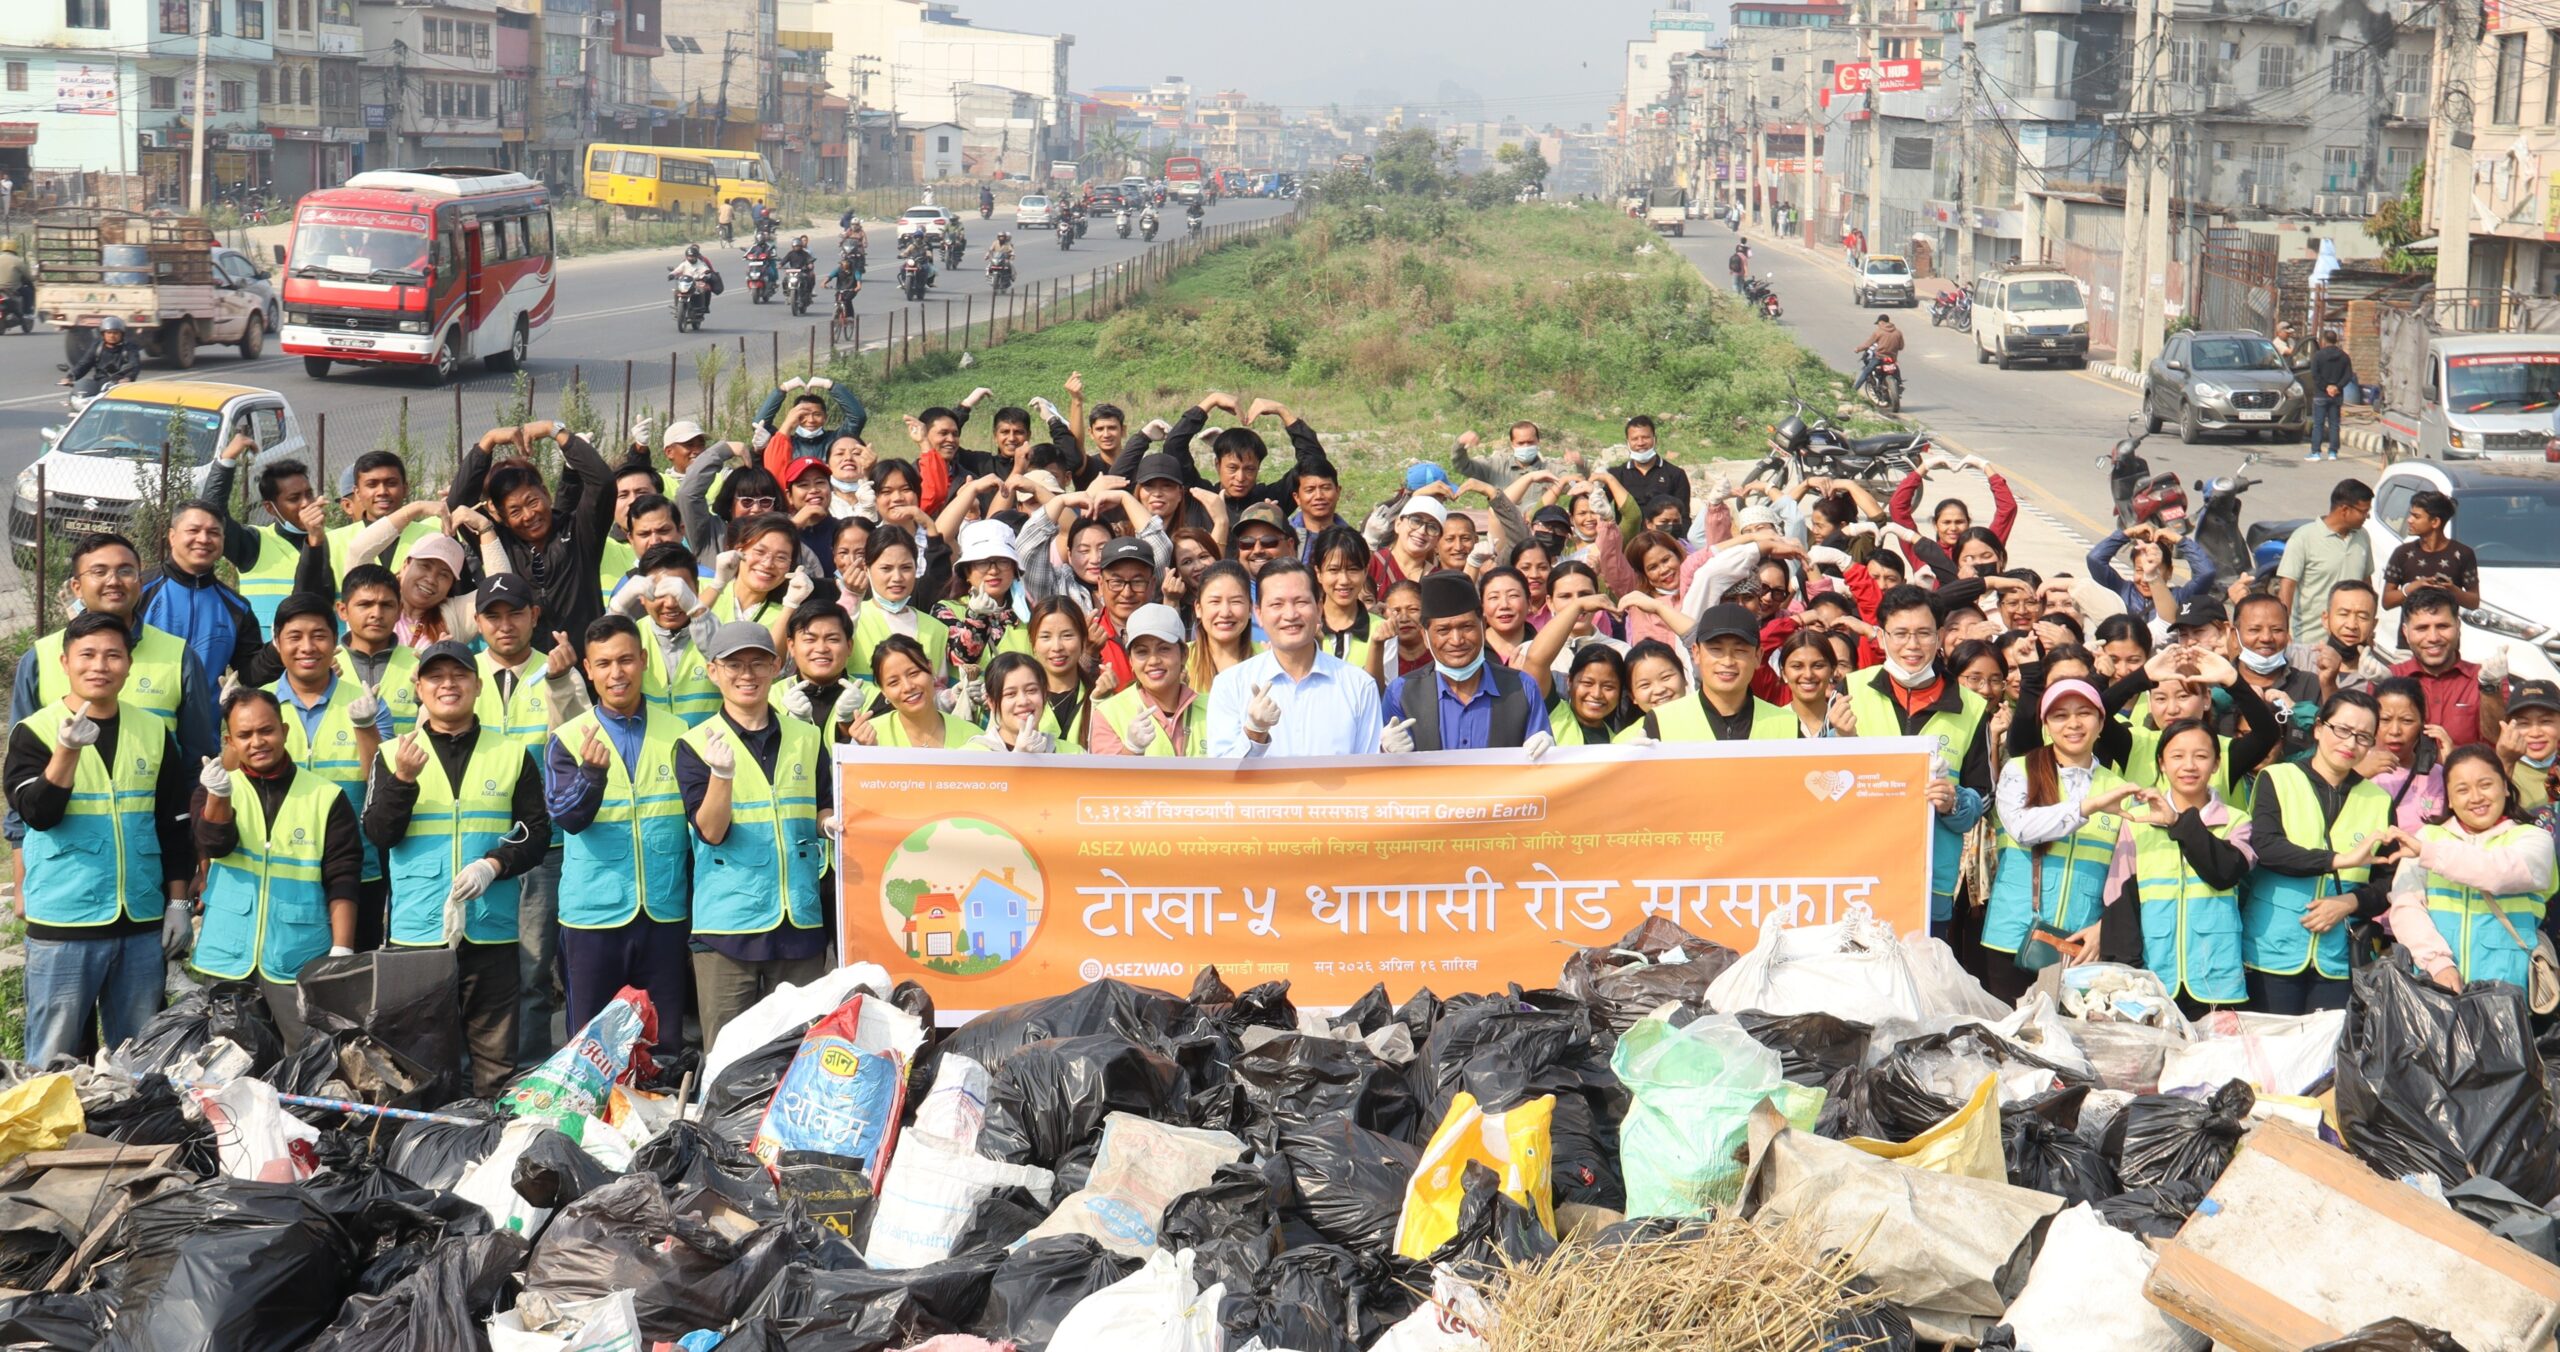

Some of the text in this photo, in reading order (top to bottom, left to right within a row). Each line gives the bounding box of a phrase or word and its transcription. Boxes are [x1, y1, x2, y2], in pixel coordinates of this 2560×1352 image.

[1887, 65, 1909, 78] HUB
[859, 780, 1008, 792] watv.org/ne asezwao.org
[1239, 803, 1303, 820] वातावरण
[1307, 803, 1369, 821] सरसफाइ
[1375, 800, 1430, 819] अभियान
[1435, 803, 1487, 819] Green
[1491, 802, 1538, 818] Earth
[1078, 827, 1725, 860] ASEZ WAO परमेश्वरको मण्डली विश्व सुसमाचार समाजको जागिरे युवा स्वयंसेवक समूह
[1305, 865, 1505, 935] धापासी
[1515, 862, 1621, 931] रोड
[1258, 961, 1290, 976] शाखा
[1313, 956, 1478, 977] सन् २०२६ अप्रिल १६ तारिख
[579, 1039, 613, 1077] Hill
[824, 1049, 854, 1073] ज्ञान
[758, 1140, 771, 1160] 20
[1108, 1207, 1153, 1241] GRADE
